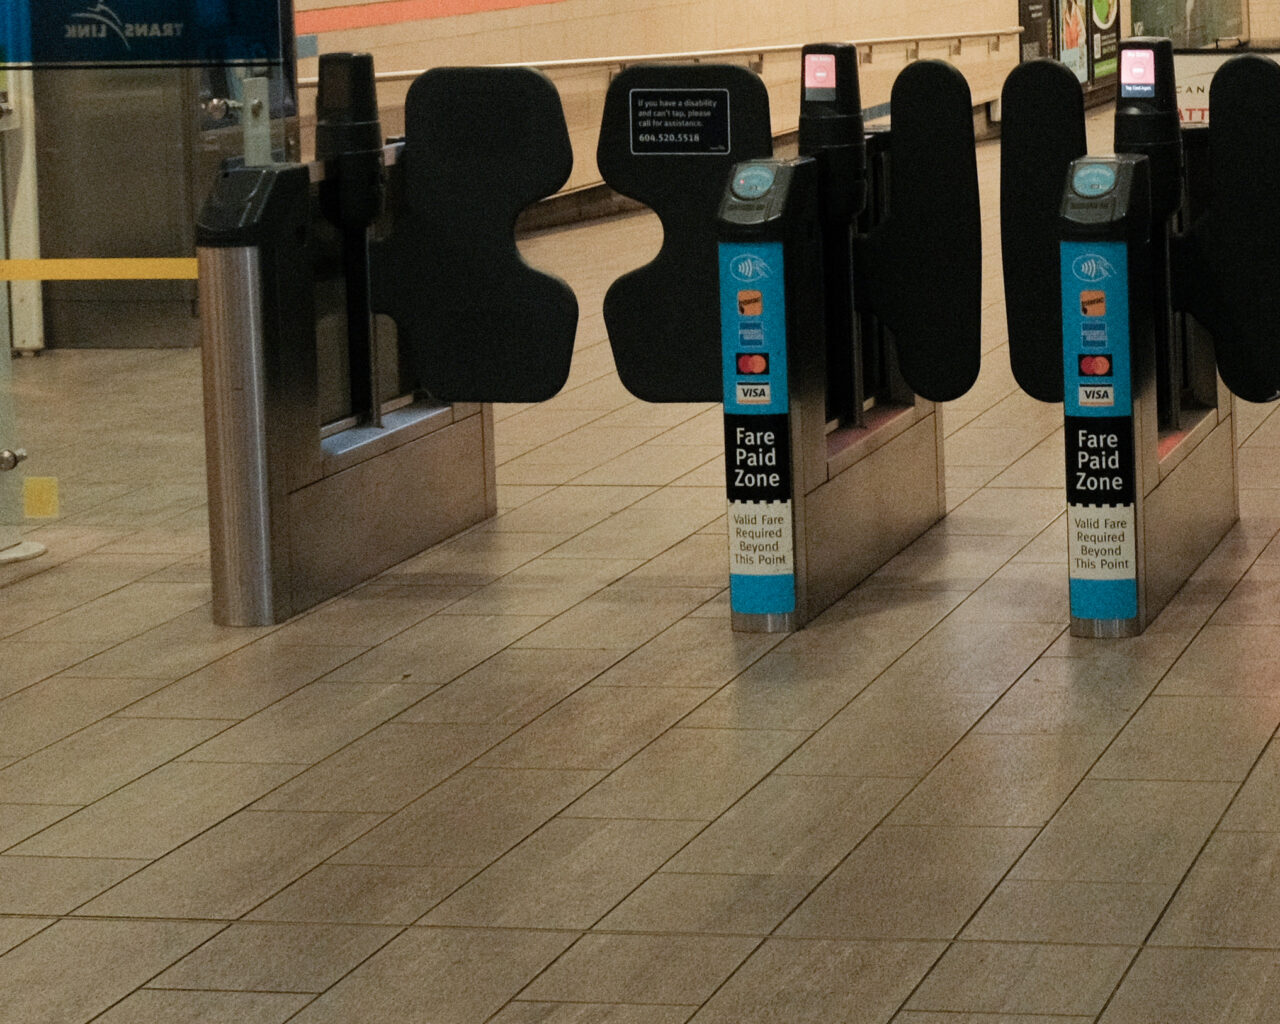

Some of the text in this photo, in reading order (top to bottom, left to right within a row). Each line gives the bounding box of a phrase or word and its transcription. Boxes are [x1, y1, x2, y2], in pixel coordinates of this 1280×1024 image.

[638, 99, 644, 107] If
[644, 100, 658, 108] you
[659, 99, 676, 107] have
[683, 98, 717, 108] disability
[638, 109, 712, 118] and can't tap, please
[639, 133, 700, 142] 604.520.5518
[741, 388, 766, 398] VISA
[1084, 390, 1109, 399] VISA
[736, 428, 775, 446] Fare
[1078, 429, 1119, 448] Fare
[736, 447, 776, 466] Paid
[1078, 451, 1119, 469] Paid
[734, 469, 780, 487] Zone
[1076, 472, 1123, 491] Zone
[733, 514, 784, 525] Valid Fare
[1074, 518, 1127, 529] Valid Fare
[735, 528, 782, 539] Required
[1076, 532, 1125, 544] Required
[739, 541, 779, 554] Beyond
[1081, 545, 1122, 557] Beyond
[735, 553, 786, 565] This Point
[1074, 558, 1129, 569] This Point
